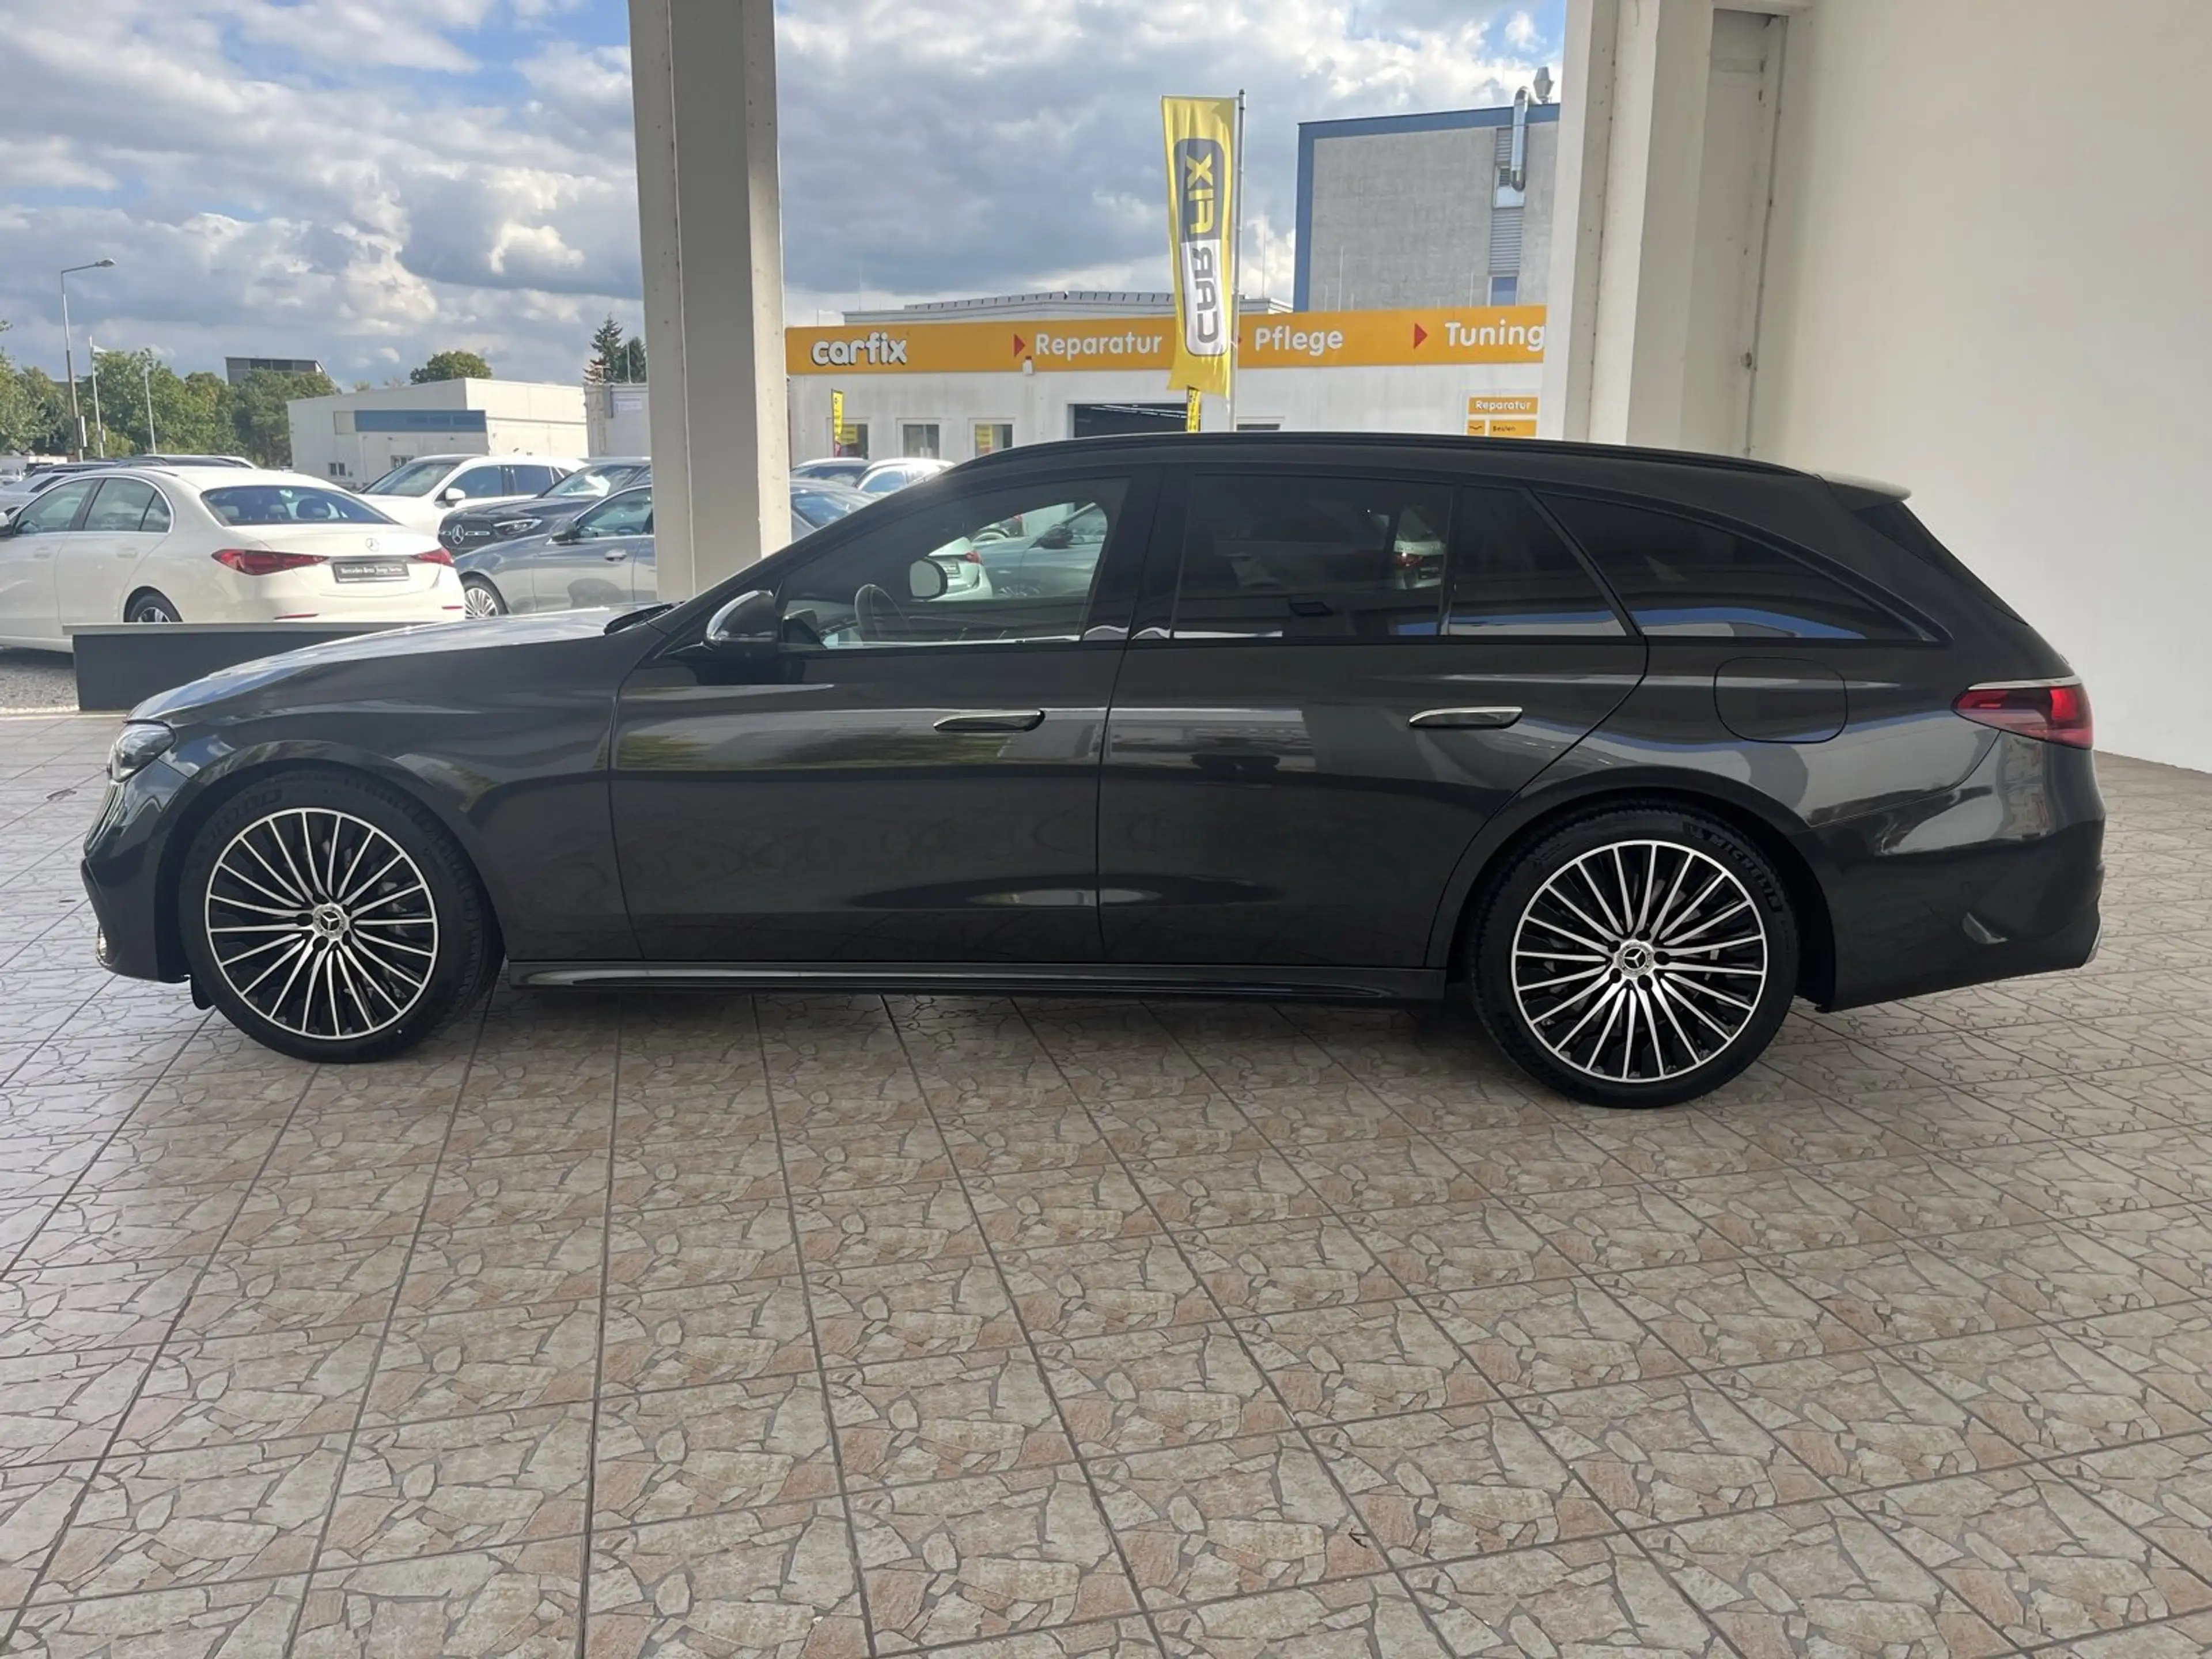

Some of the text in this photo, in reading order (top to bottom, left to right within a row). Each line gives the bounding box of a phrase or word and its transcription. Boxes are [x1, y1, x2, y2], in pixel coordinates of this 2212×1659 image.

[812, 332, 907, 365] carfix
[1036, 332, 1162, 359] Reparatur
[1255, 326, 1344, 355] Pflege
[1445, 319, 1546, 351] Tuning
[1476, 400, 1531, 411] Reparatur
[1709, 834, 1781, 908] MICHELIN
